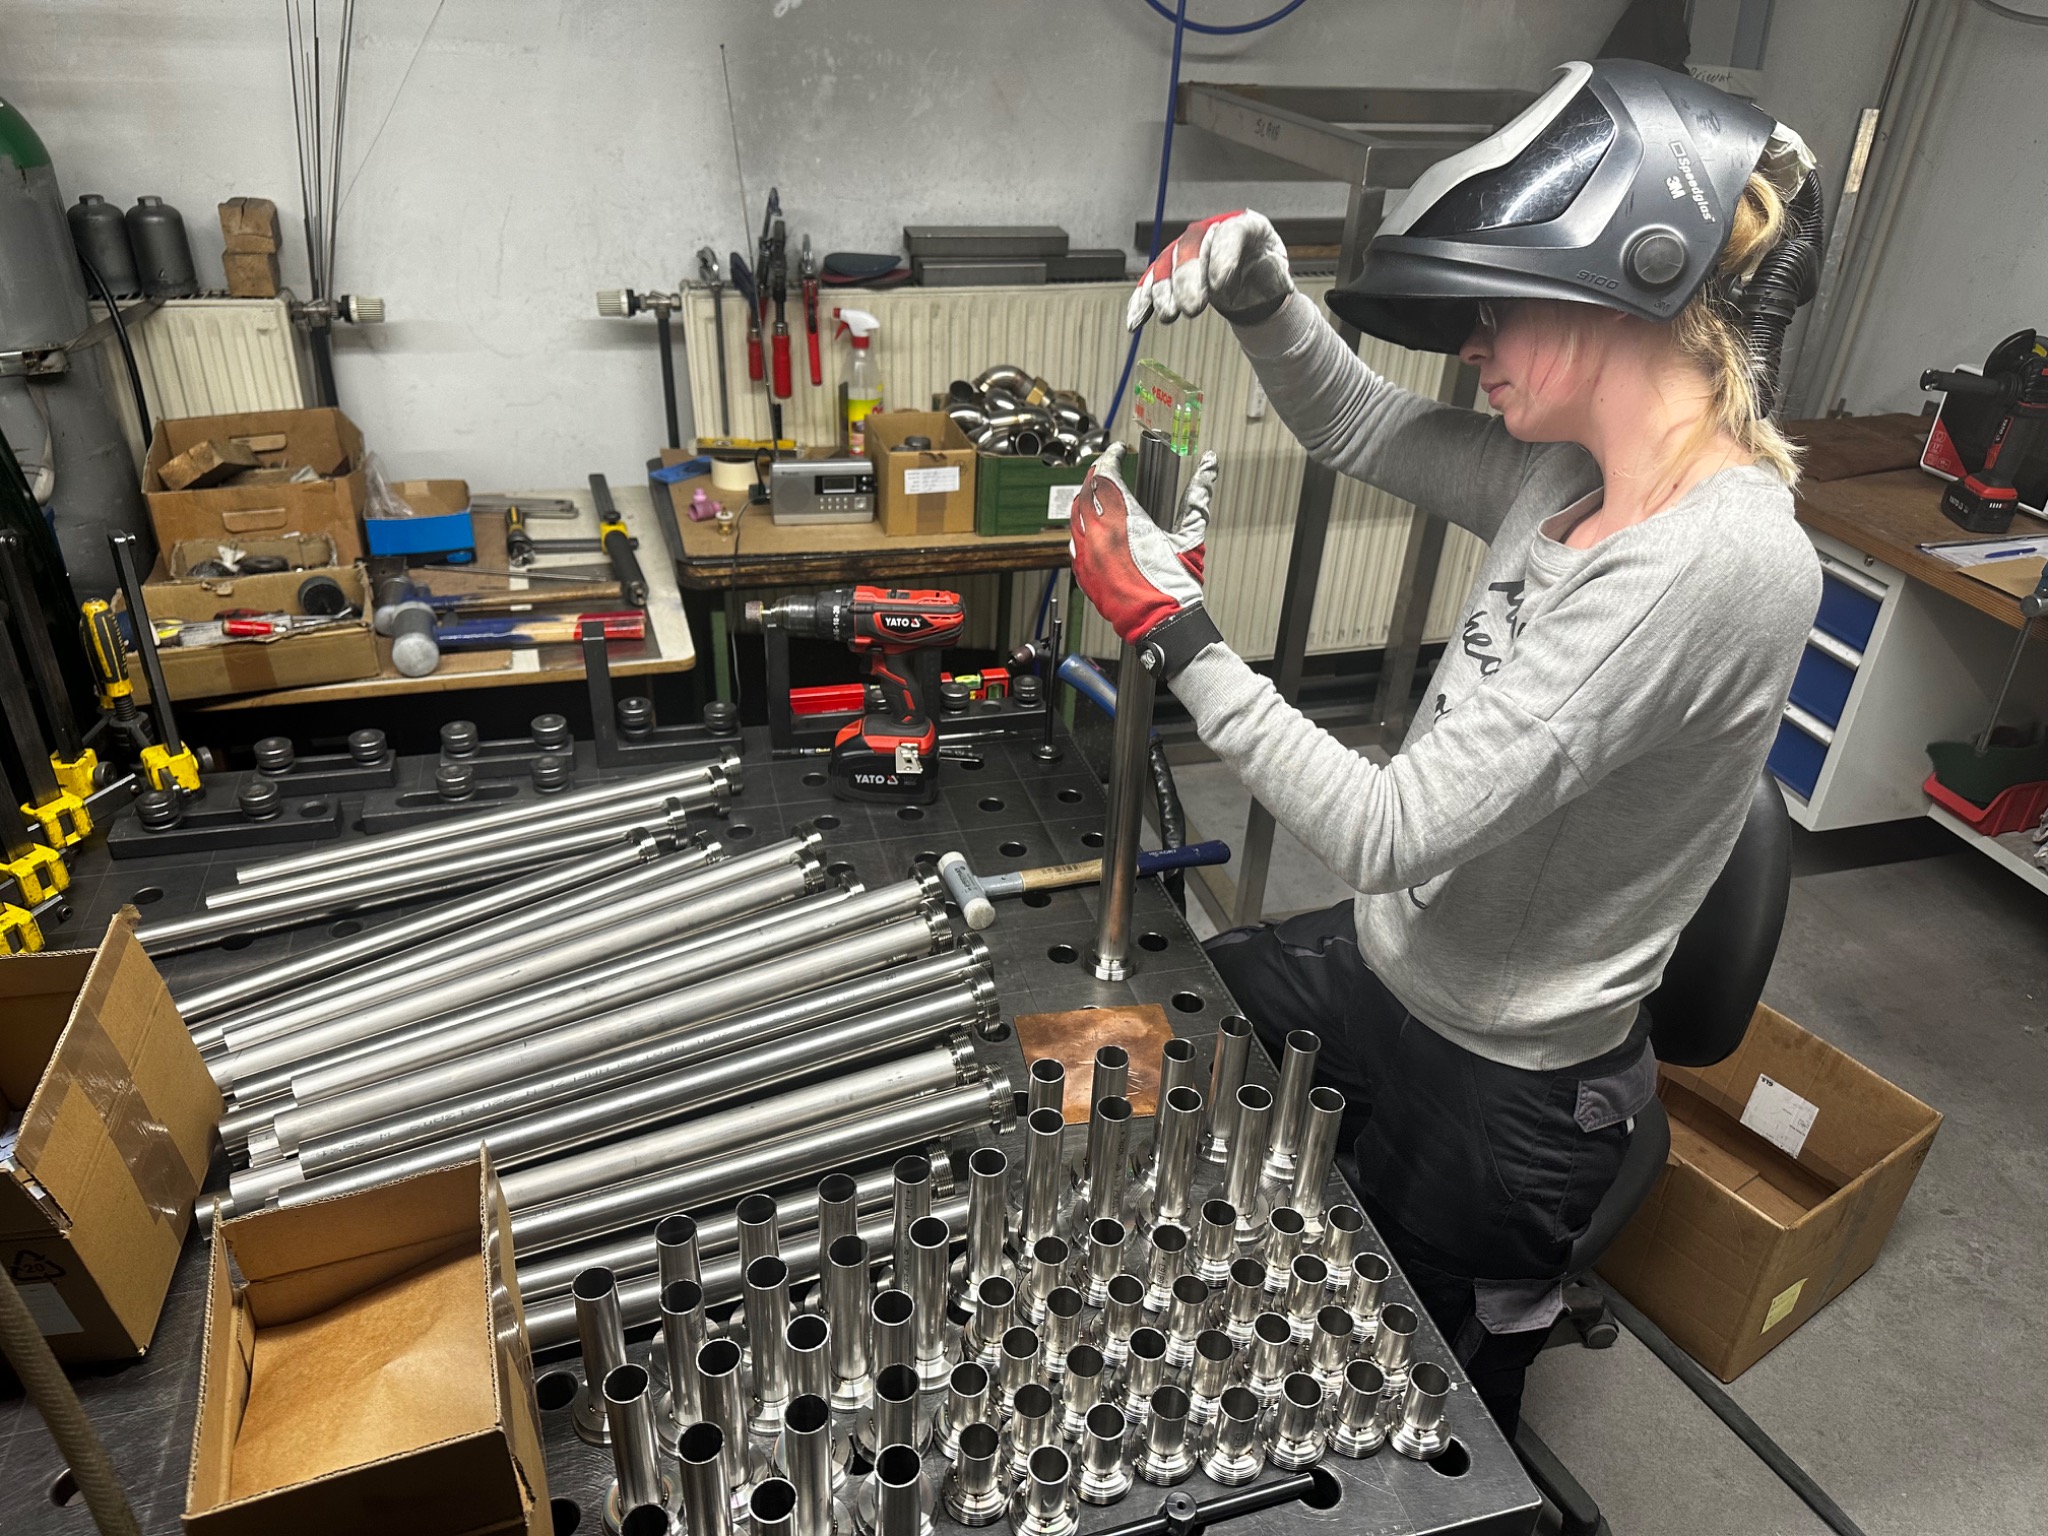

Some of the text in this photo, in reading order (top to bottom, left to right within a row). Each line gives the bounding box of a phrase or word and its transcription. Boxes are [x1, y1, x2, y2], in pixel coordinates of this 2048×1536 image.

[1666, 175, 1686, 199] 3M
[1576, 269, 1619, 289] 9100
[885, 617, 910, 627] YATO
[854, 774, 885, 785] YATO
